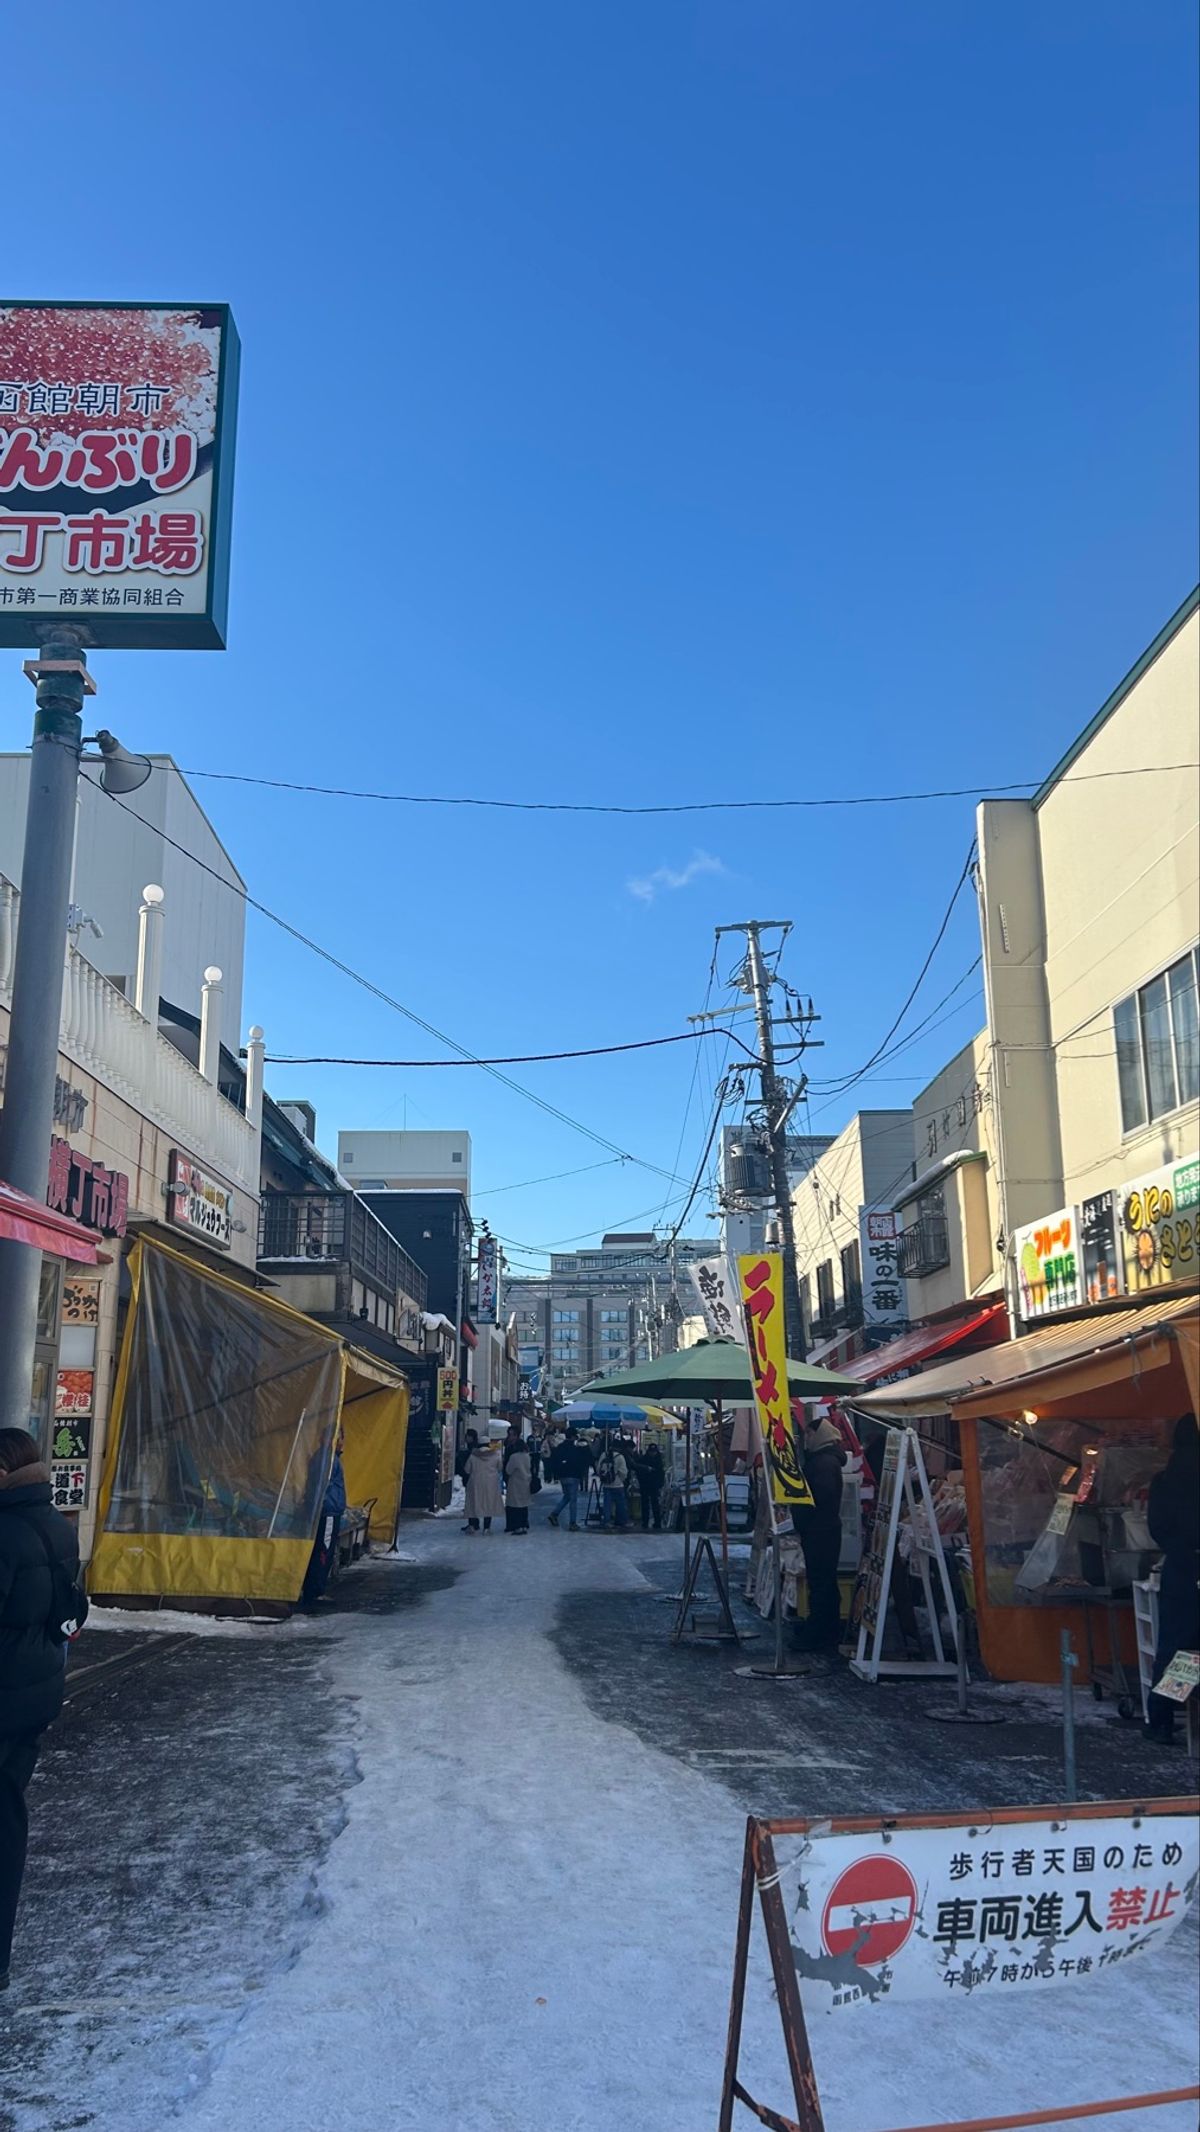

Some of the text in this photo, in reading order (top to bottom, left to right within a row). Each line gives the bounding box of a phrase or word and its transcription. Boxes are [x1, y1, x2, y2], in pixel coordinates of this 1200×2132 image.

[0, 431, 193, 490] んぶり
[48, 1134, 129, 1237] 横丁市場
[1129, 1185, 1173, 1232] うにの
[1033, 1218, 1071, 1257] フルーツ
[1159, 1213, 1200, 1269] さと
[869, 1241, 901, 1311] 味の一番
[949, 1841, 1183, 1880] 歩行者天国のため
[932, 1881, 1181, 1944] 車両進入禁止
